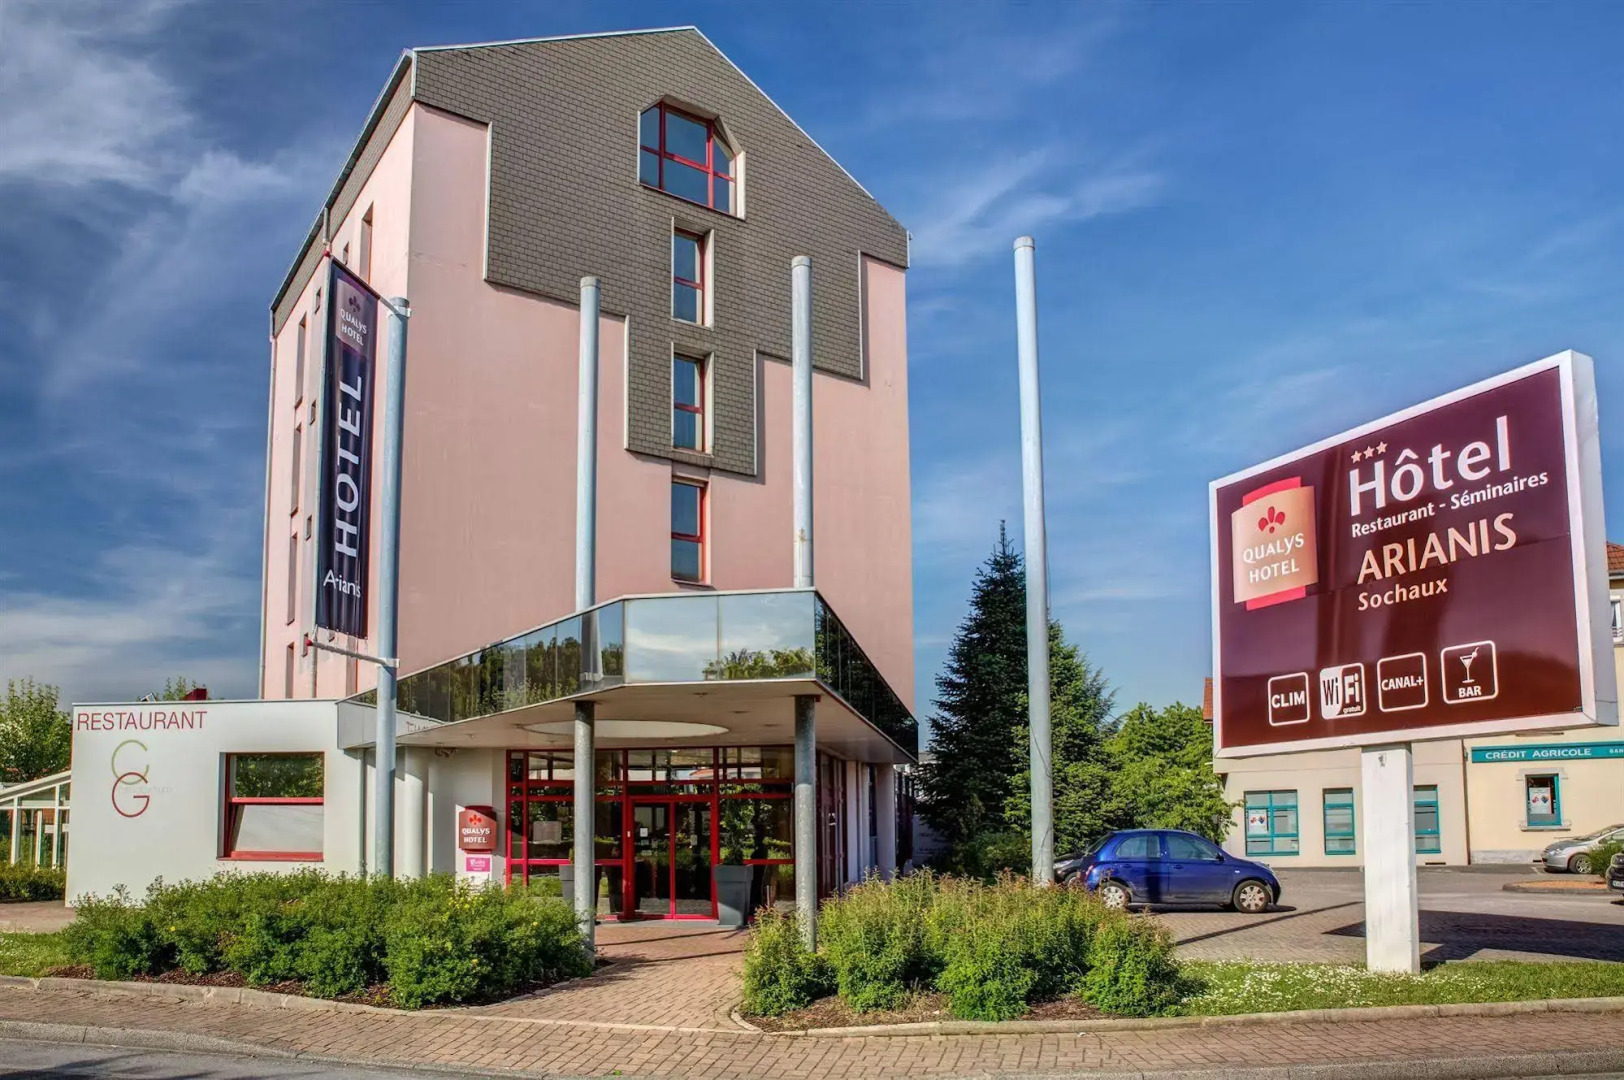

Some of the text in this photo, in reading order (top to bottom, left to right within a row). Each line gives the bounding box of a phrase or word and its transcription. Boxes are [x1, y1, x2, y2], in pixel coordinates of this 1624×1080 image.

[341, 309, 368, 335] QUALYS
[341, 323, 364, 346] HOTEL
[335, 375, 362, 558] HOTEL
[1349, 415, 1511, 517] Hôtel
[1351, 503, 1435, 538] Restaurant
[1450, 471, 1549, 510] Séminaires
[1242, 532, 1305, 564] QUALYS
[1357, 512, 1517, 585] ARIANIS
[1249, 558, 1300, 584] HOTEL
[1358, 578, 1448, 611] Sochaux
[1381, 675, 1424, 691] CANAL+
[1458, 685, 1482, 698] BAR
[1271, 690, 1306, 708] CLIM
[1342, 705, 1362, 714] gratuit
[77, 711, 207, 731] RESTAURANT
[1485, 750, 1527, 759] CRÉDIT
[1532, 748, 1592, 758] AGRICOLE
[461, 827, 491, 836] QUALYS
